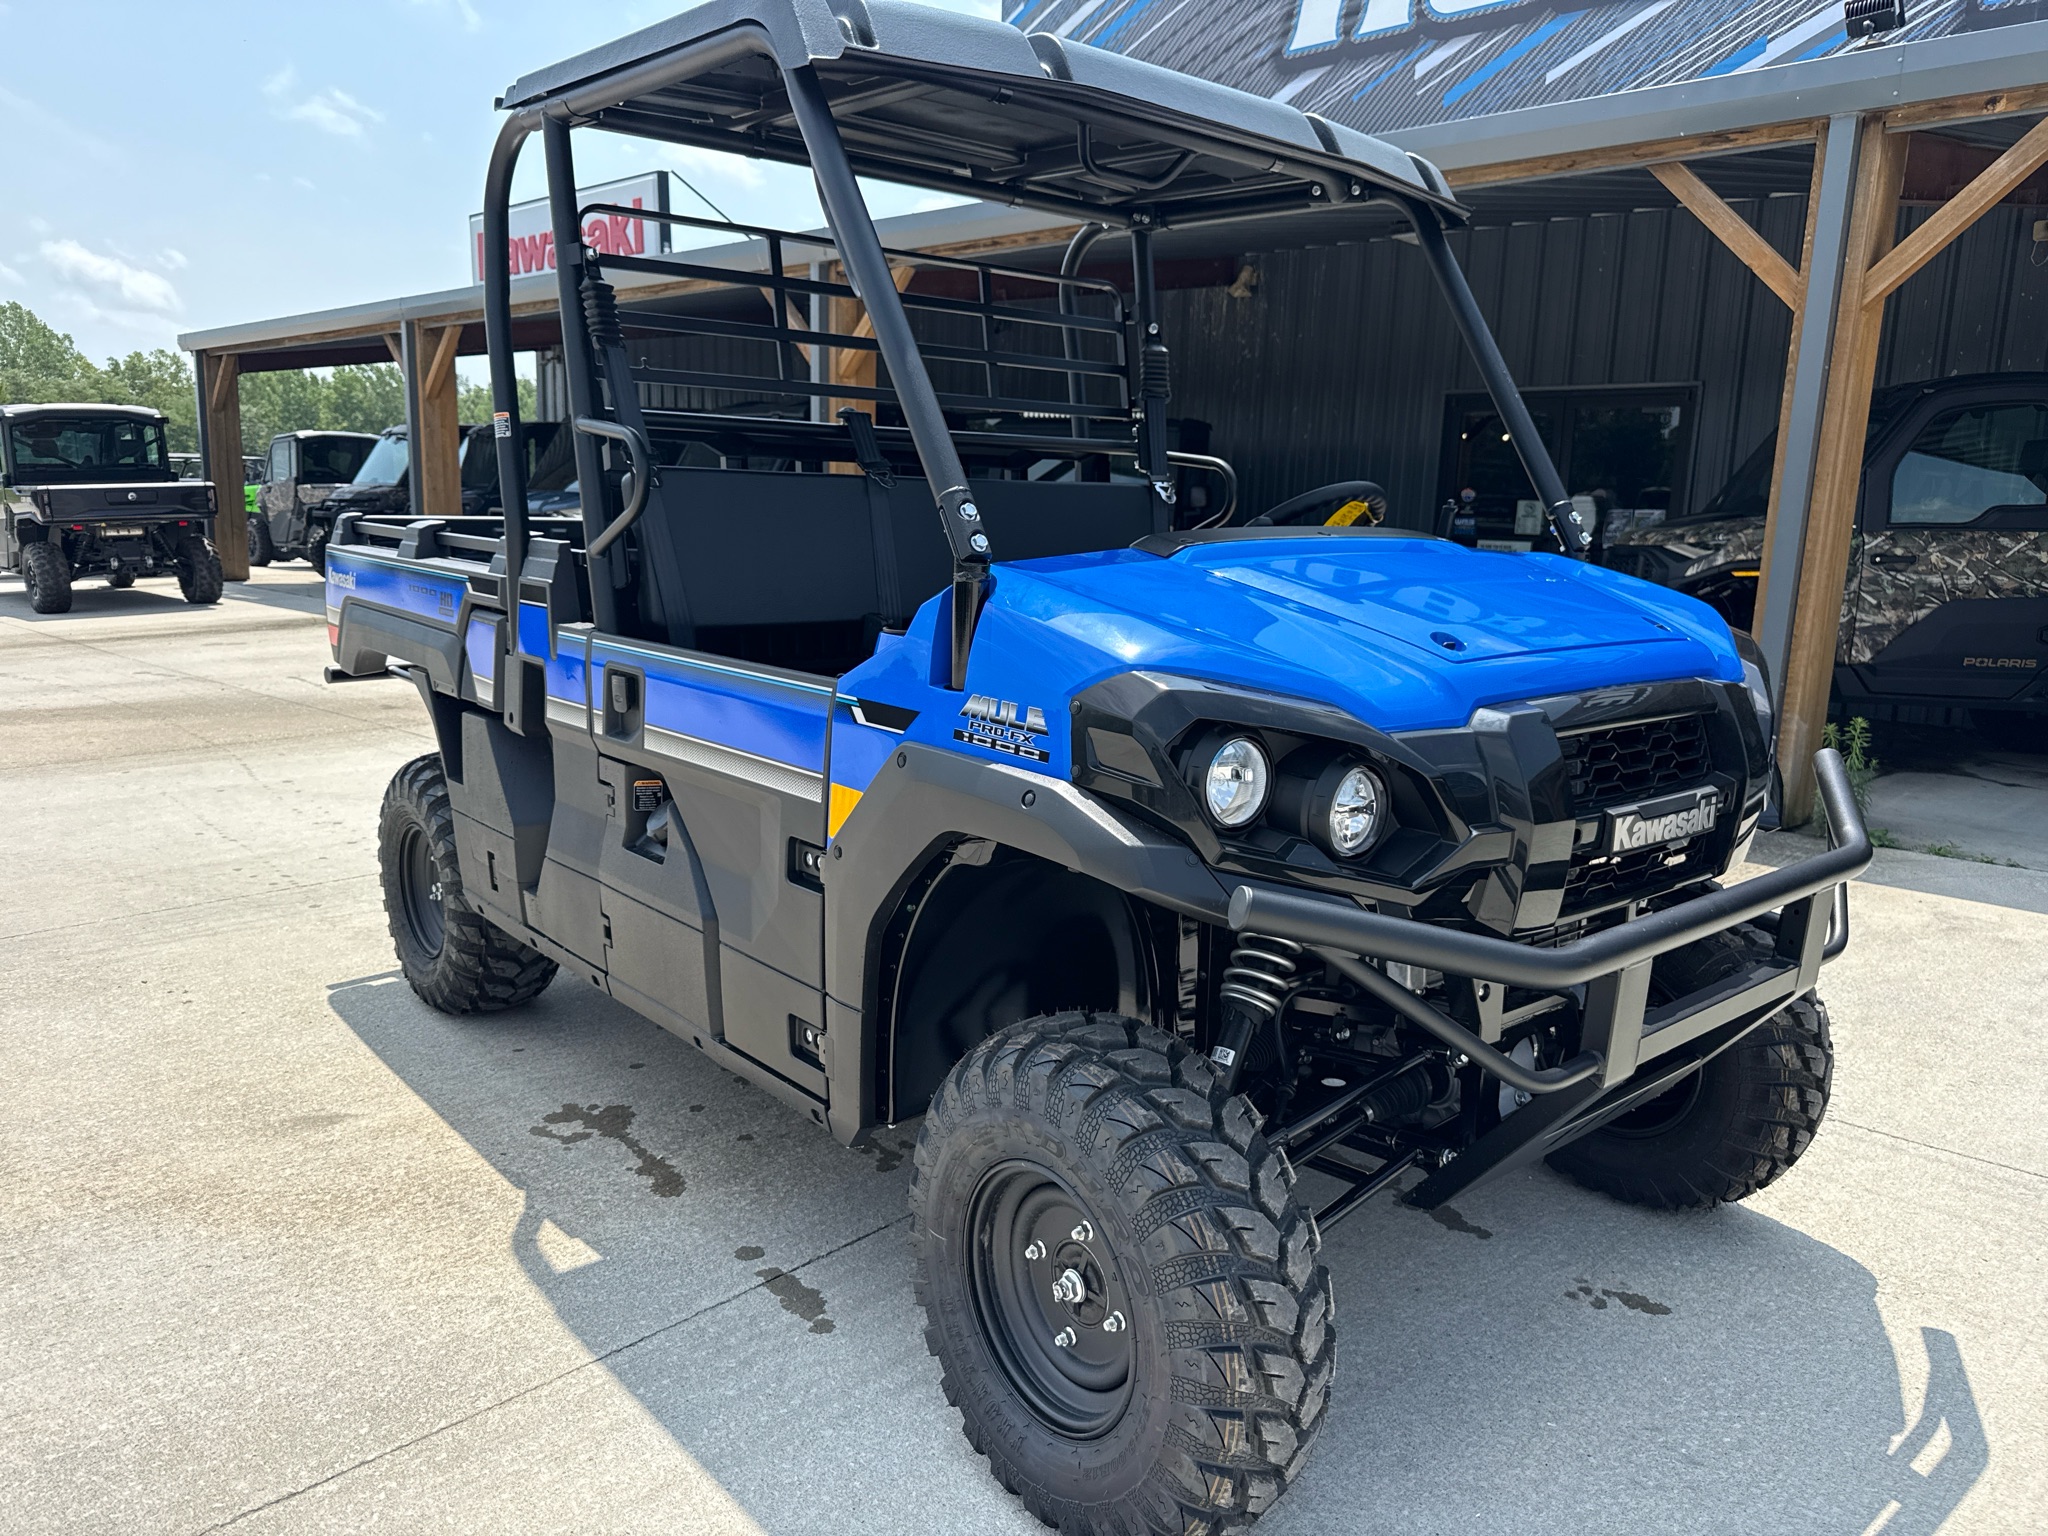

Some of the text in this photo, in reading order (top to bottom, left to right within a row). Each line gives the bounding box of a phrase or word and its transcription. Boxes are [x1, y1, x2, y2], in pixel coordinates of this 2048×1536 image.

[328, 565, 357, 590] Kawasaki
[1963, 657, 2037, 668] POLARIS
[958, 693, 1050, 737] MULE
[961, 731, 1041, 760] 1000
[1612, 796, 1717, 852] Kawasaki
